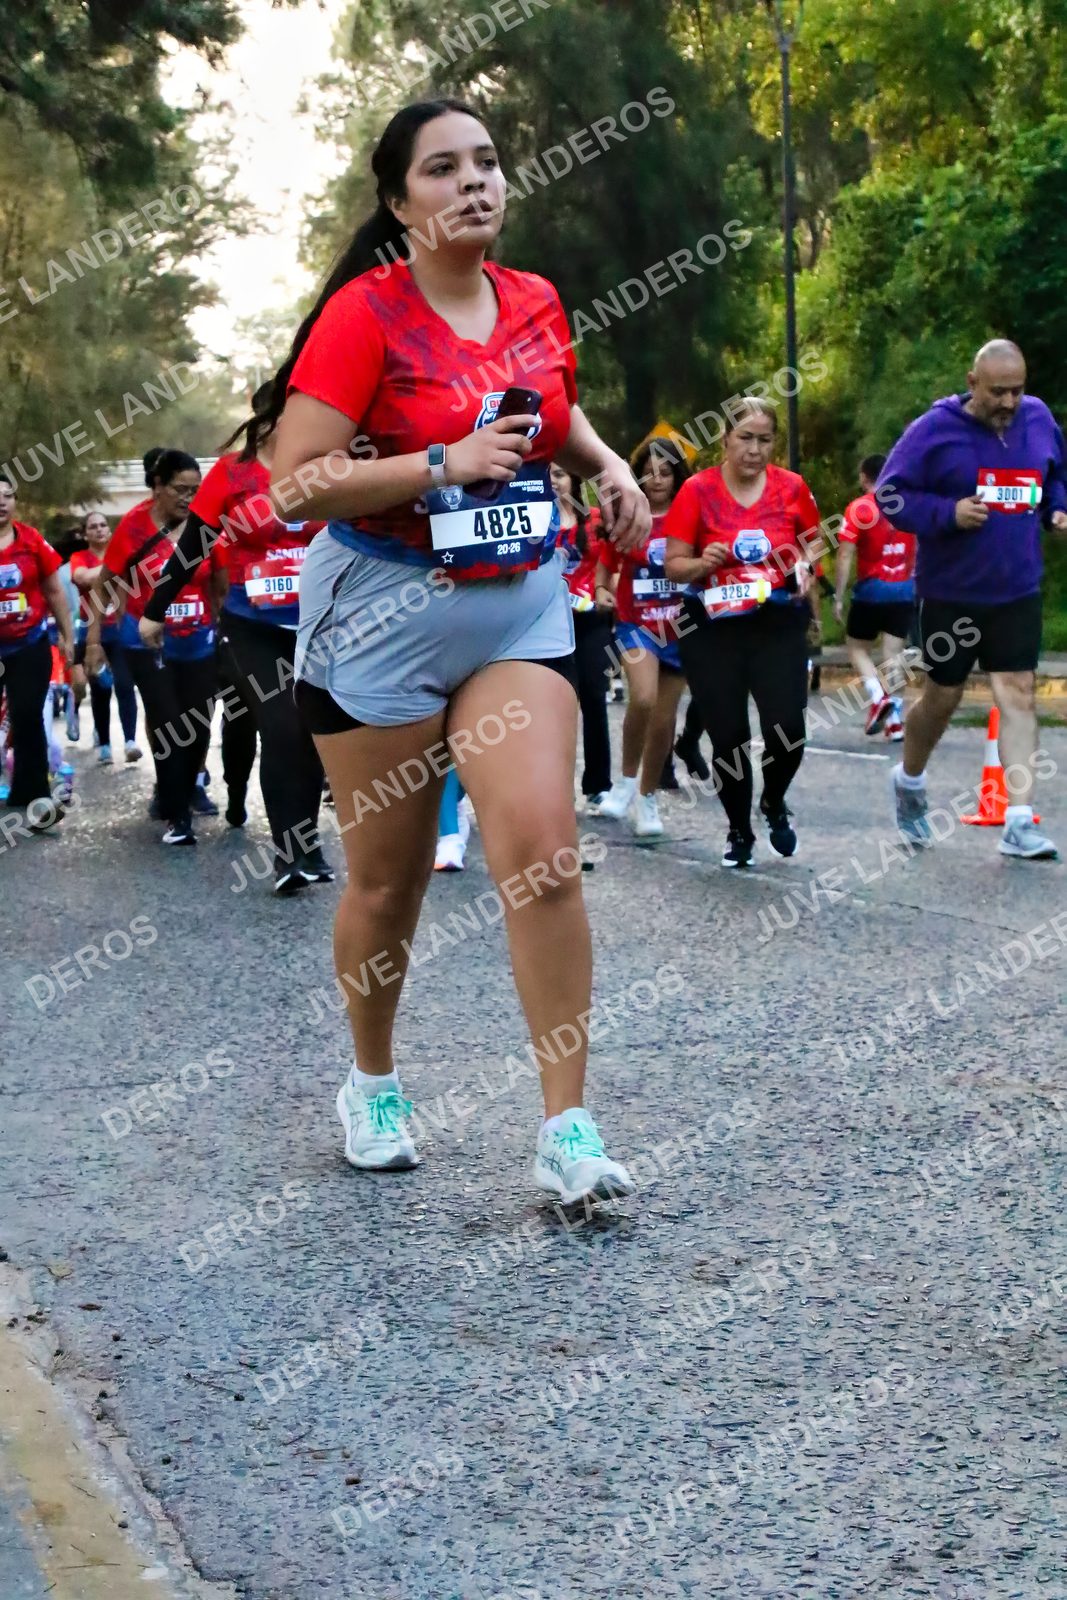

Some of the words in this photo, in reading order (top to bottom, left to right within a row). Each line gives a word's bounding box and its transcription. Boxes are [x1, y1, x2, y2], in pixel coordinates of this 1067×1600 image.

[996, 487, 1024, 501] 3001
[473, 505, 532, 540] 4825
[265, 547, 309, 561] SANTI
[264, 577, 293, 592] 3160
[721, 584, 750, 600] 3282
